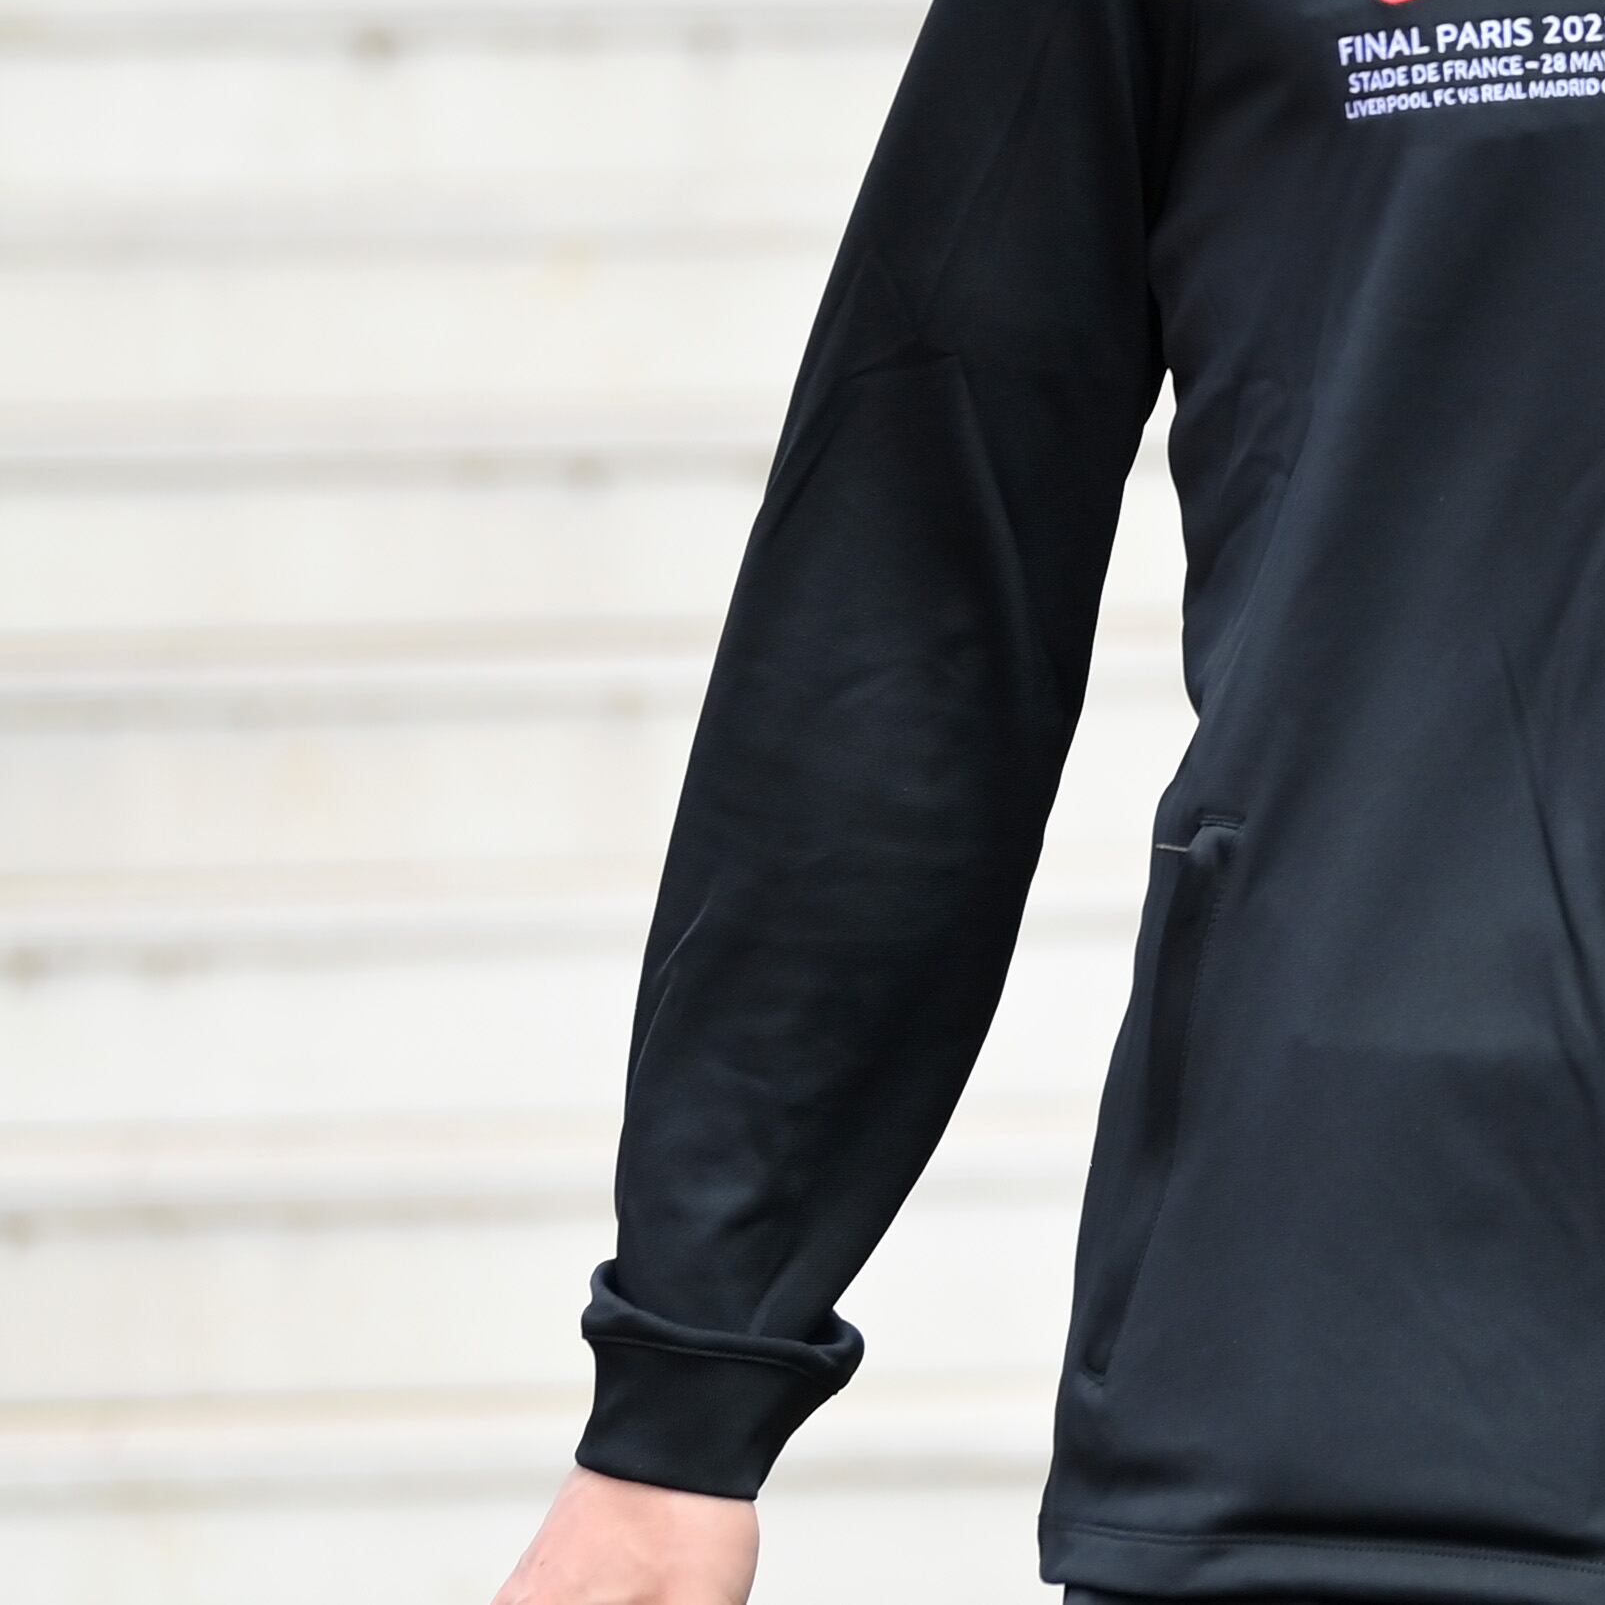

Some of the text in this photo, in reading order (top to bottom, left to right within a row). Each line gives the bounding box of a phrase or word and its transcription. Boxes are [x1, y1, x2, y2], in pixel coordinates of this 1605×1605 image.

[1338, 26, 1431, 66] FINAL
[1436, 17, 1534, 54] PARIS
[1348, 65, 1410, 93] STADE
[1411, 61, 1441, 85] DE
[1442, 54, 1524, 83] FRANCE
[1540, 52, 1567, 74] 28
[1345, 90, 1433, 119] LIVERPOOL
[1433, 87, 1457, 107] FC
[1457, 86, 1480, 104] VS
[1480, 81, 1527, 103] REAL
[1528, 77, 1600, 99] MADRID
